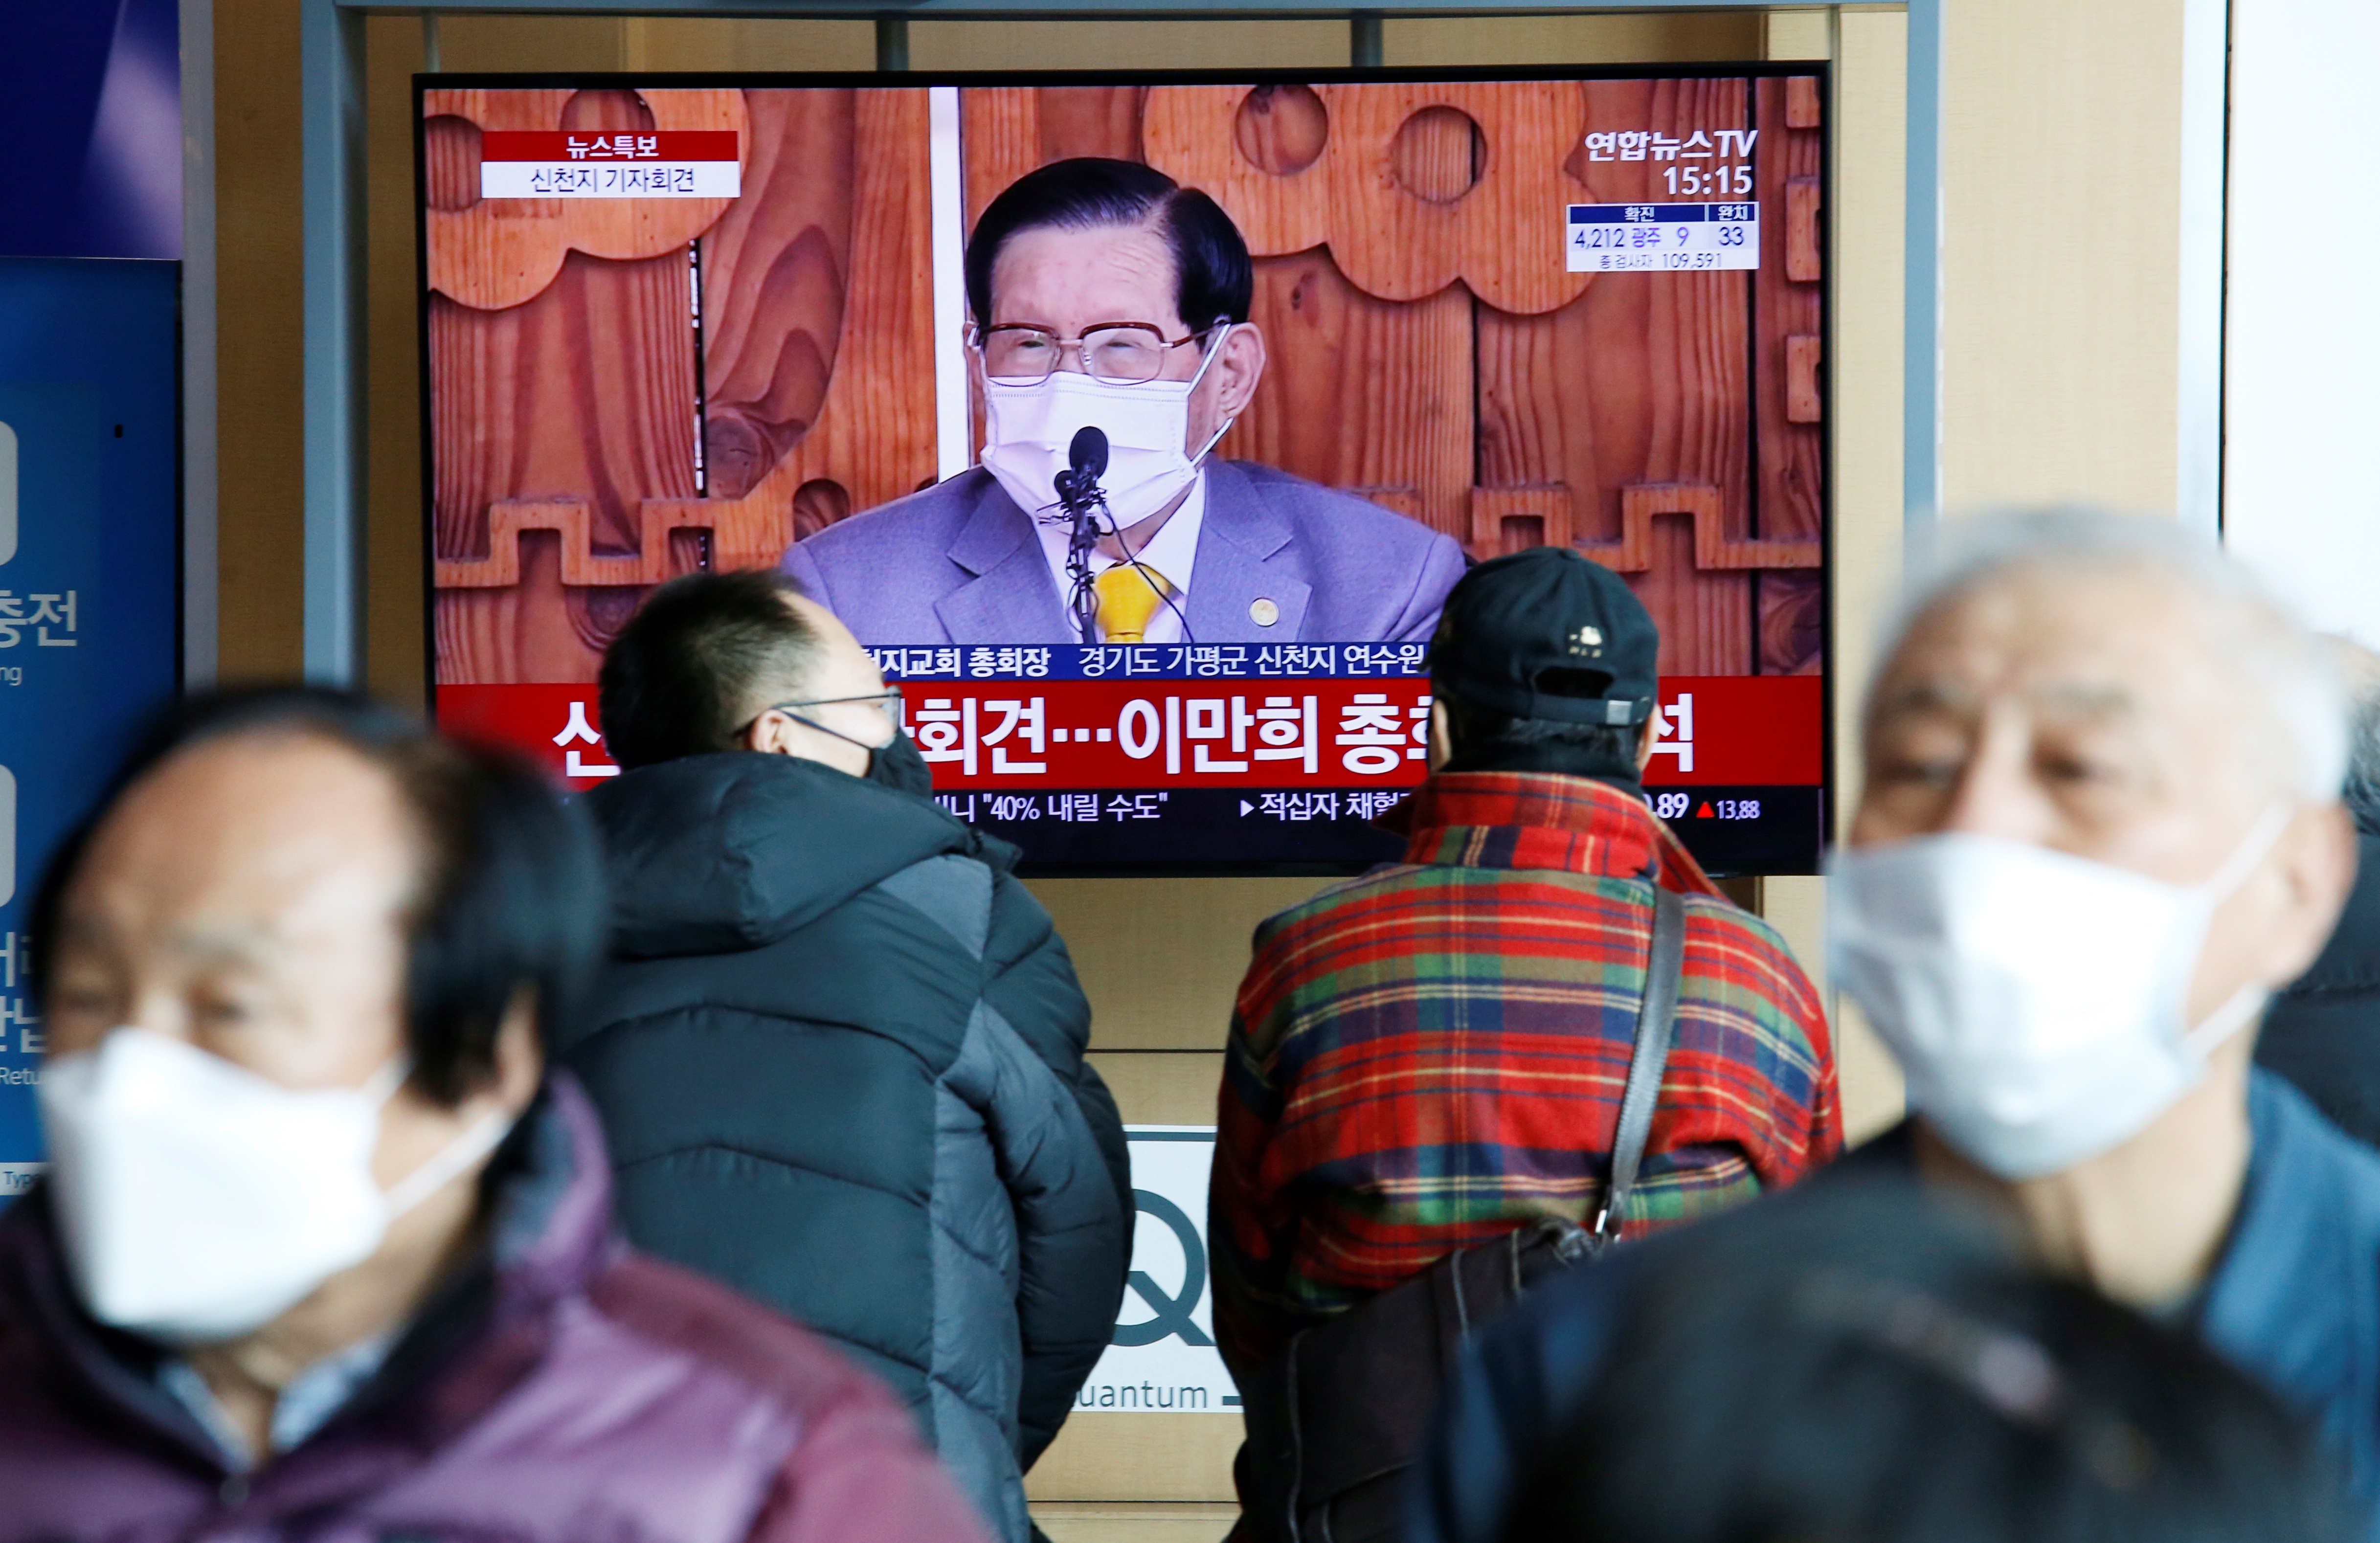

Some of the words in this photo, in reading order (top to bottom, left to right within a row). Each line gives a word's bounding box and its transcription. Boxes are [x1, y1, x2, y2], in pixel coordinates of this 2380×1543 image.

[566, 135, 659, 159] 뉴스특보
[1584, 130, 1758, 161] 연합뉴스TV
[530, 168, 597, 193] 신천지
[605, 168, 695, 193] 기자회견
[1663, 165, 1752, 195] 15:15
[1625, 206, 1655, 222] 확진
[1718, 205, 1748, 221] 완치
[1573, 228, 1625, 249] 4,212
[1632, 227, 1662, 248] 광주
[1677, 226, 1689, 246] 9
[1718, 226, 1744, 246] 33
[1615, 253, 1653, 268] 검사자
[1662, 253, 1722, 269] 109,591
[861, 648, 961, 677] 지교회
[968, 647, 1051, 677] 총회장
[1078, 647, 1160, 676] 경기도
[1167, 646, 1248, 675] 가평군
[1255, 646, 1335, 674] 신천지
[1343, 645, 1424, 674] 연수원
[552, 701, 621, 777] 신
[1335, 693, 1433, 775] 총
[935, 795, 974, 823] 니
[983, 793, 1040, 822] "40%
[1048, 794, 1099, 822] 내릴
[1106, 792, 1167, 822] 수도"
[1259, 792, 1340, 821] 적십자
[1346, 792, 1411, 820] 채혈
[1717, 800, 1760, 820] 13.88
[0, 1067, 41, 1085] Retu
[3, 1171, 39, 1189] Typ
[1076, 1380, 1208, 1408] uantum
